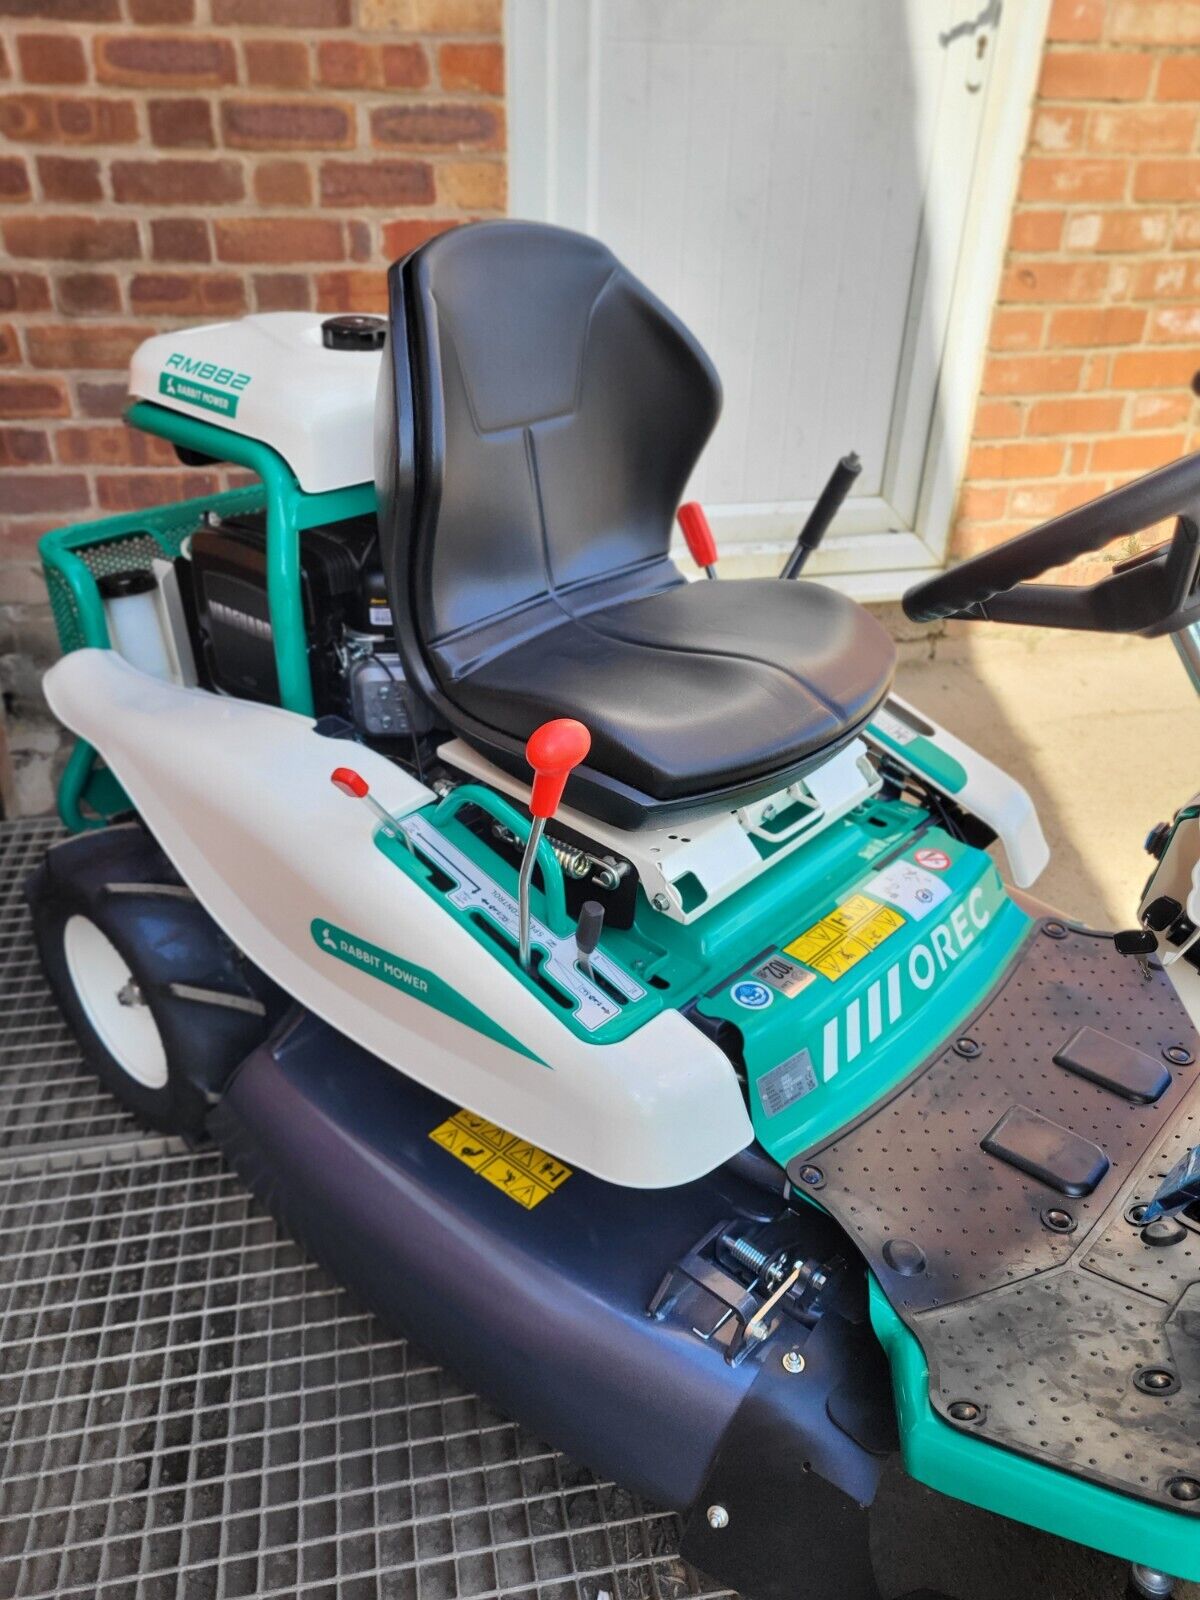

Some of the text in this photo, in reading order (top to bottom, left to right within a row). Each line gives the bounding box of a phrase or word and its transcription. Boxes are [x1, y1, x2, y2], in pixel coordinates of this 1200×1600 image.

[165, 352, 252, 391] RM882
[176, 383, 202, 401] RABBIT
[908, 886, 990, 991] OREC
[339, 939, 429, 994] RABBIT MOWER
[762, 959, 793, 980] 102
